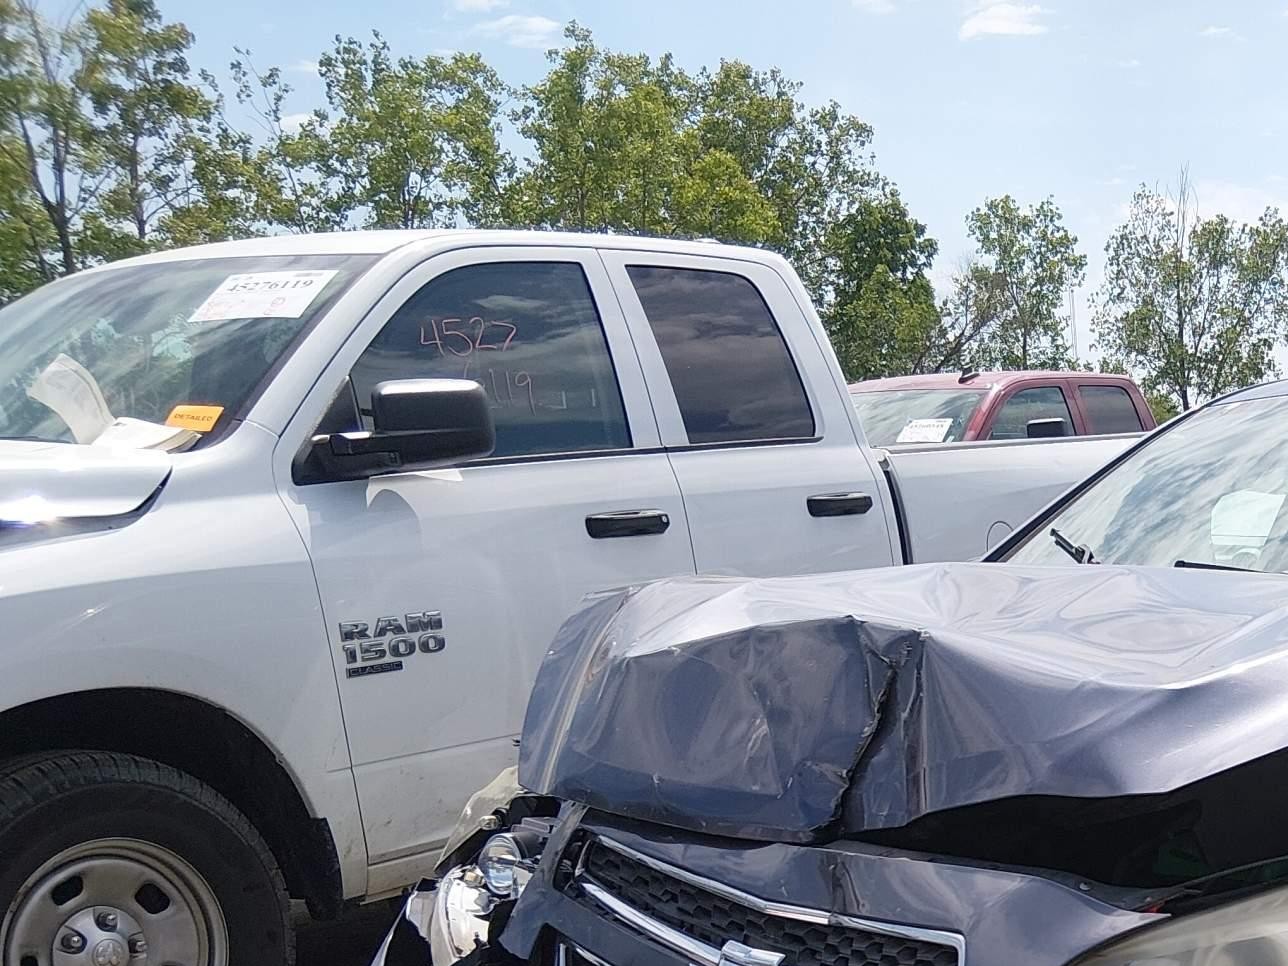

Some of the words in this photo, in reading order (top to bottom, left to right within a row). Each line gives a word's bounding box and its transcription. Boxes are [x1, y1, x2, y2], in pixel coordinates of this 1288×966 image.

[227, 279, 314, 292] 45276119
[420, 316, 517, 357] 4527
[338, 610, 443, 642] RAM
[342, 633, 446, 665] 1500
[348, 661, 403, 677] CLASSIC
